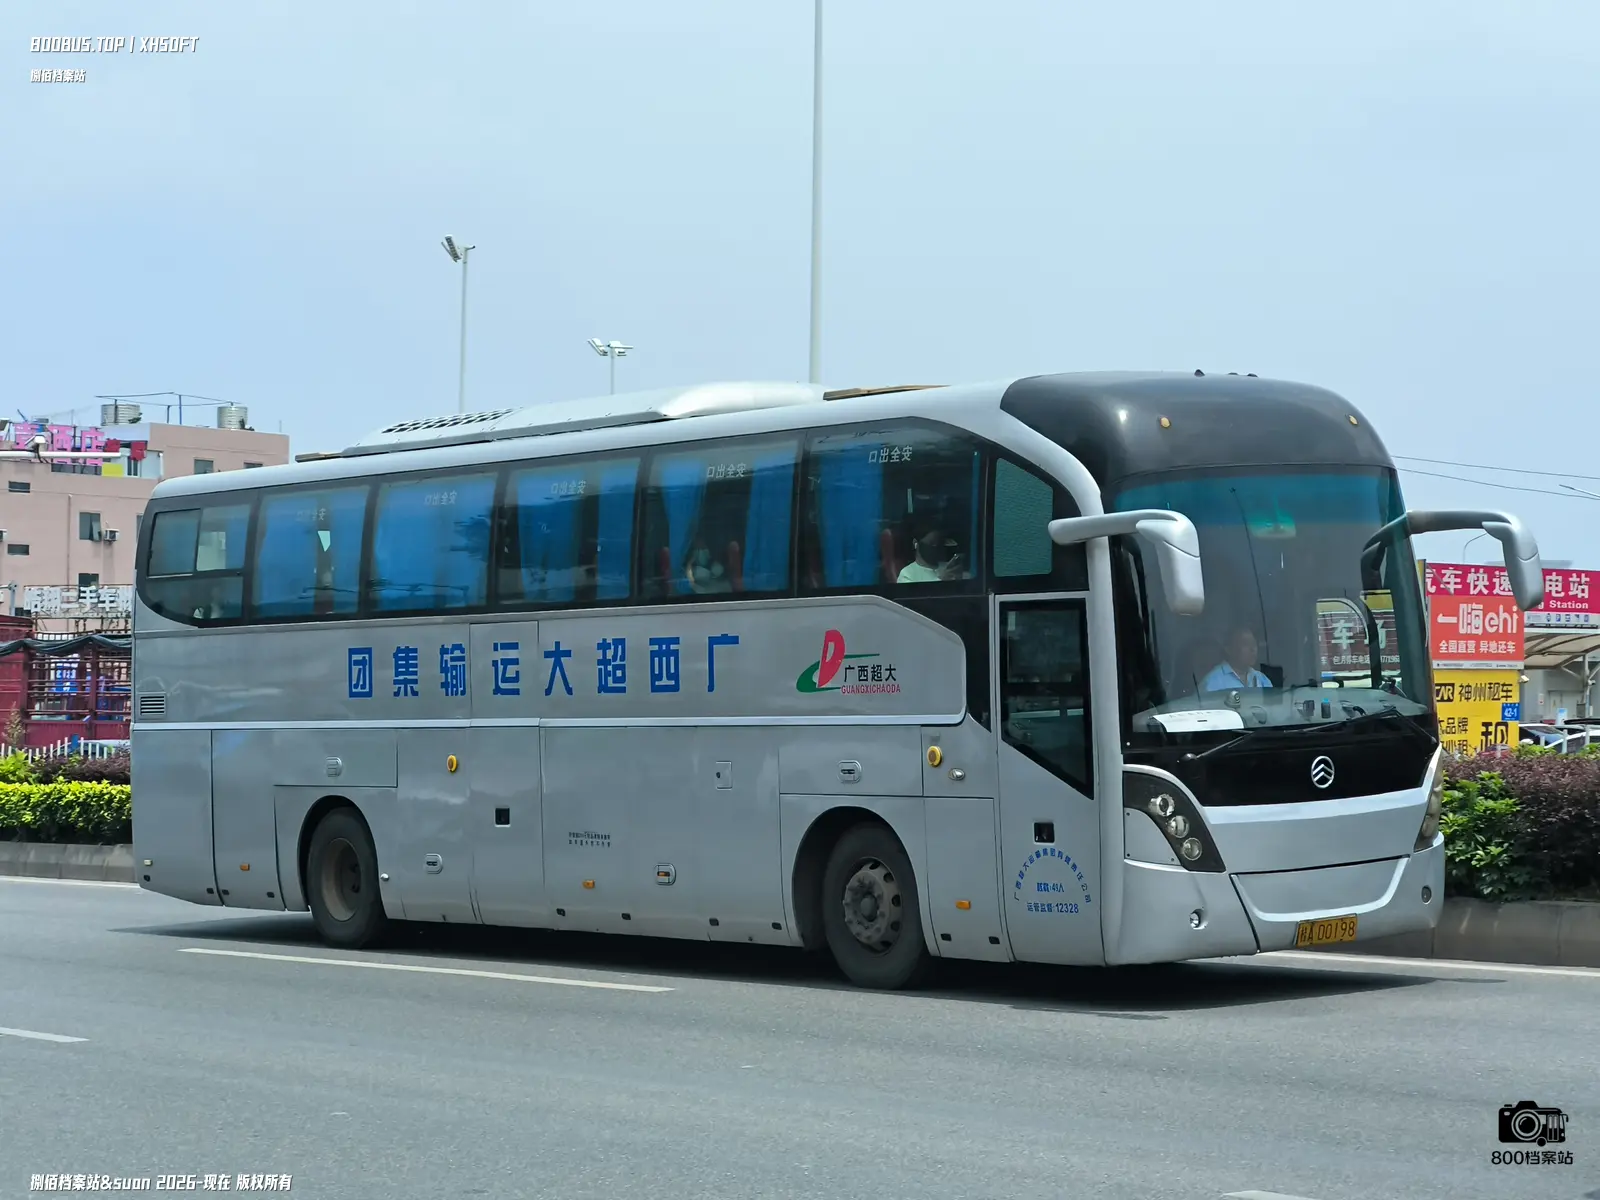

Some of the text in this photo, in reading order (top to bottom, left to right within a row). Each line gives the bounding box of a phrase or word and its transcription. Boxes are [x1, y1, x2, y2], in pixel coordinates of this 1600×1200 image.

[1426, 567, 1590, 598] 汽车快速电站
[1549, 599, 1589, 610] Station
[844, 664, 897, 682] 广西超大
[841, 684, 901, 694] GUANGXICHAODA
[1458, 682, 1513, 702] 神州租车
